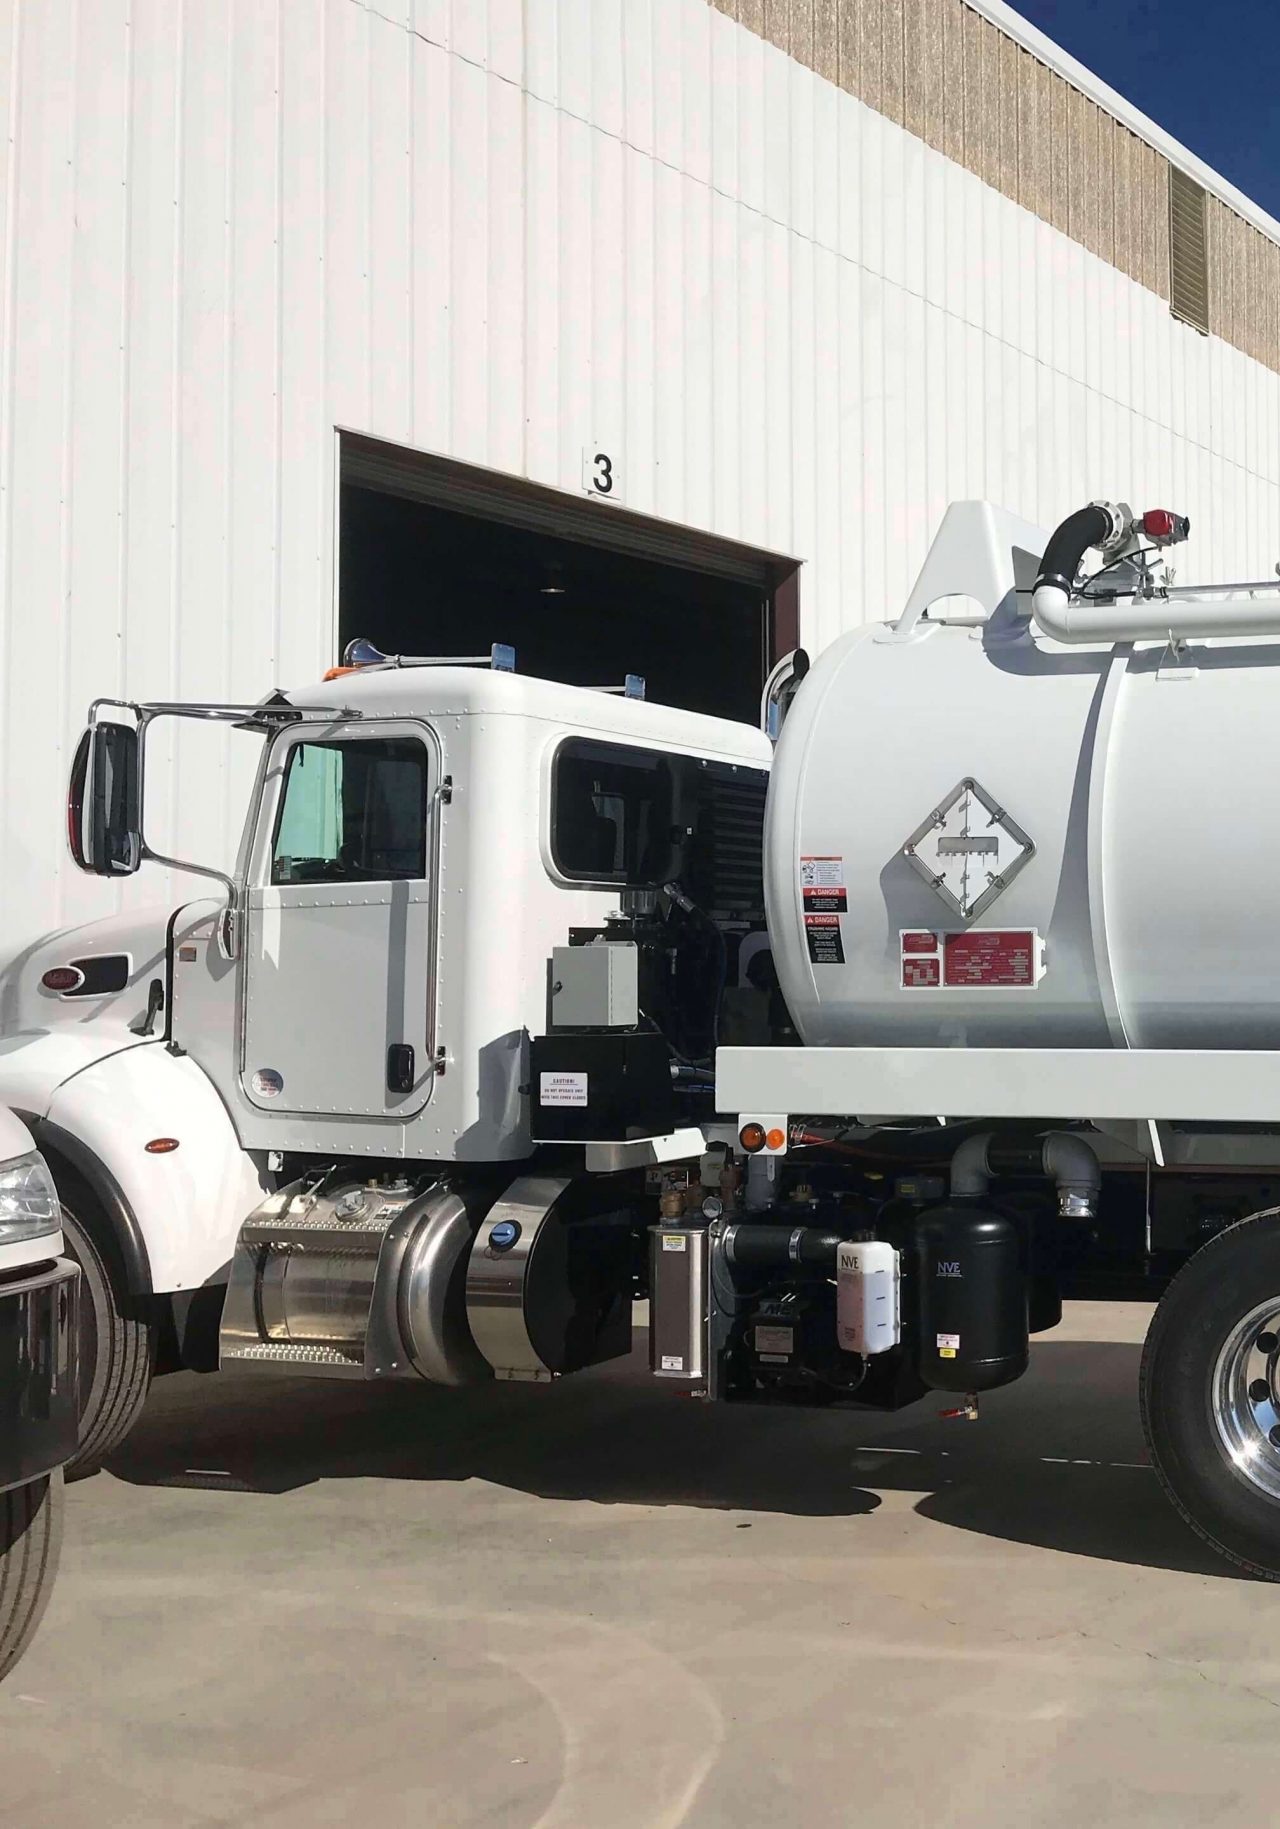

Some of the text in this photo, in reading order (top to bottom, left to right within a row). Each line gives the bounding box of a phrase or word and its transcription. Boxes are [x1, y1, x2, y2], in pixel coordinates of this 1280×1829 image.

[592, 453, 613, 493] 3
[841, 1254, 859, 1270] NVE
[937, 1261, 961, 1274] NVE
